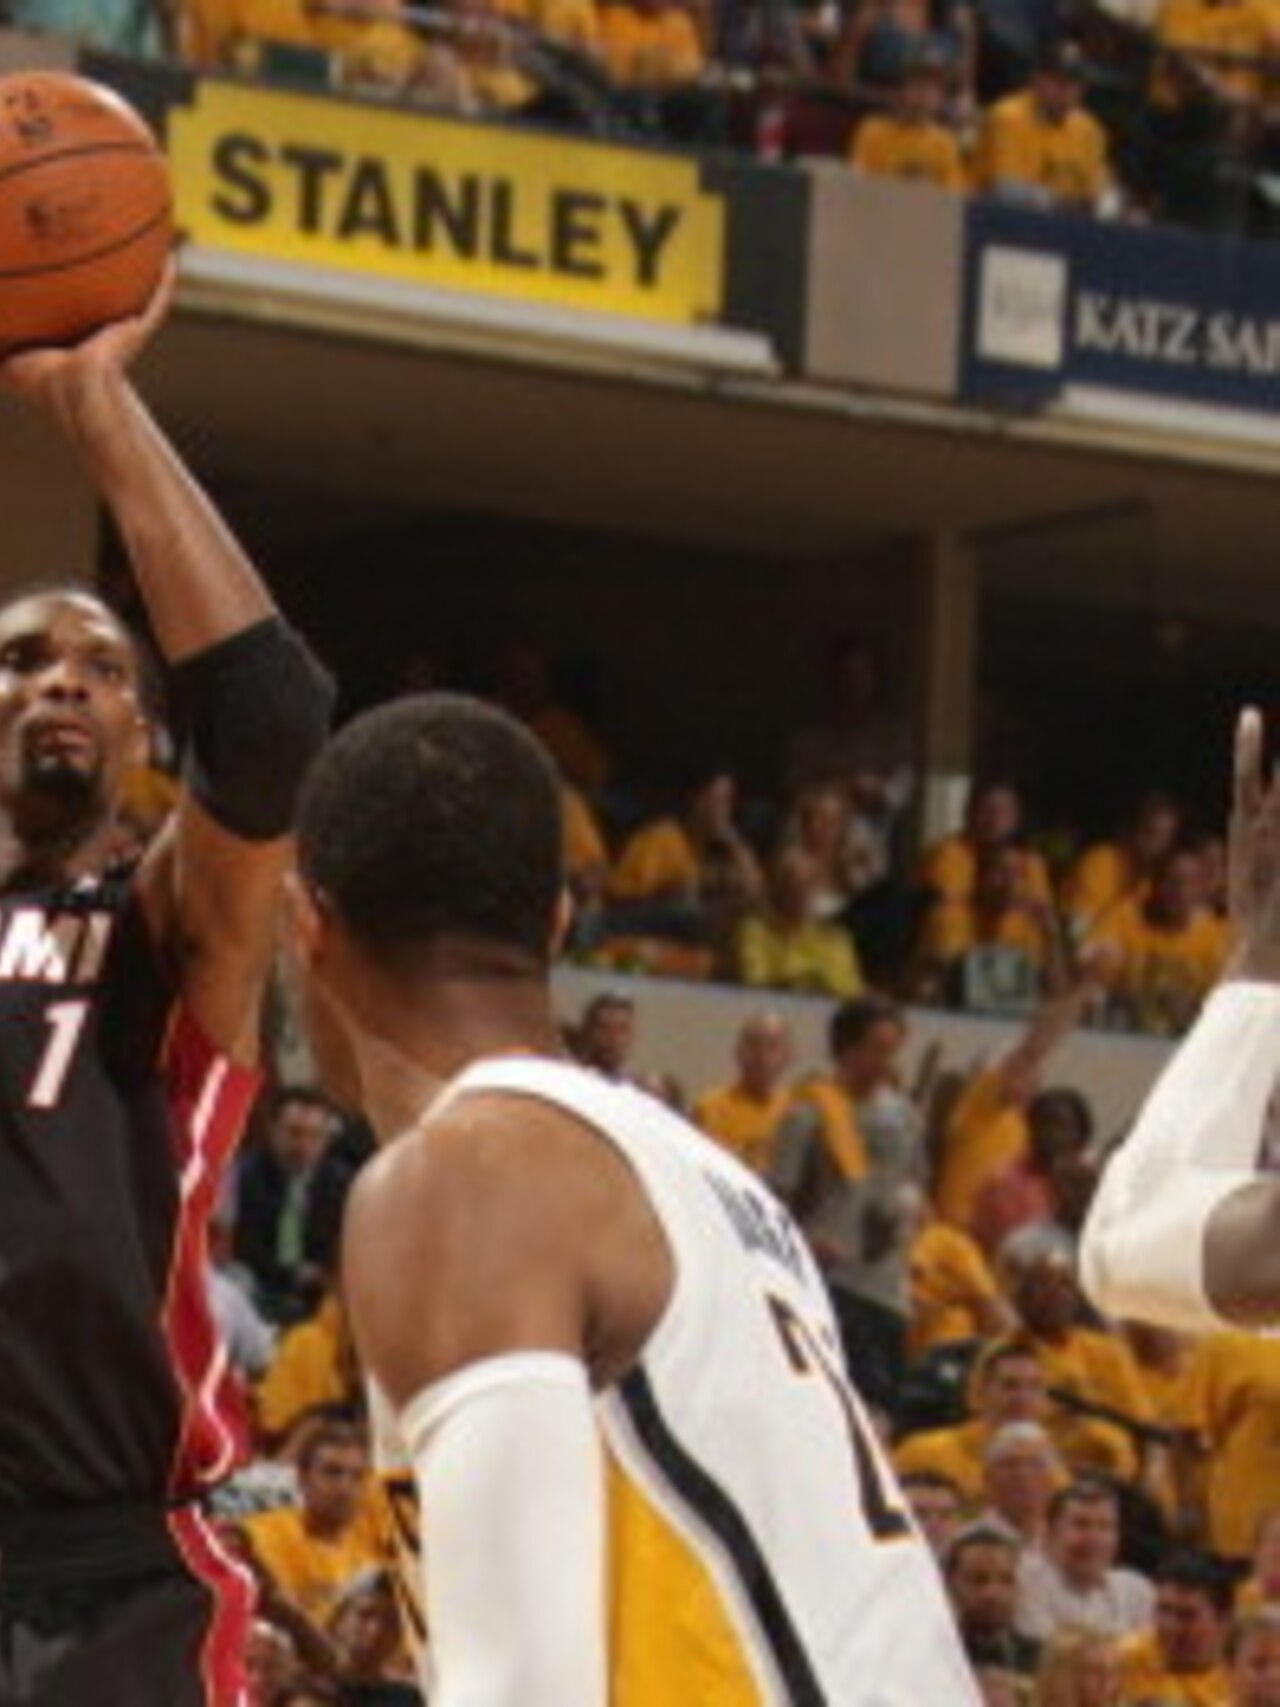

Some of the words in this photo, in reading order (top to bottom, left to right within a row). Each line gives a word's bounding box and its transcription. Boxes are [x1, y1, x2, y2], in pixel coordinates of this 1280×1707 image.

[209, 131, 682, 288] STANLEY
[1075, 292, 1197, 362] KATZ
[29, 999, 89, 1108] 1
